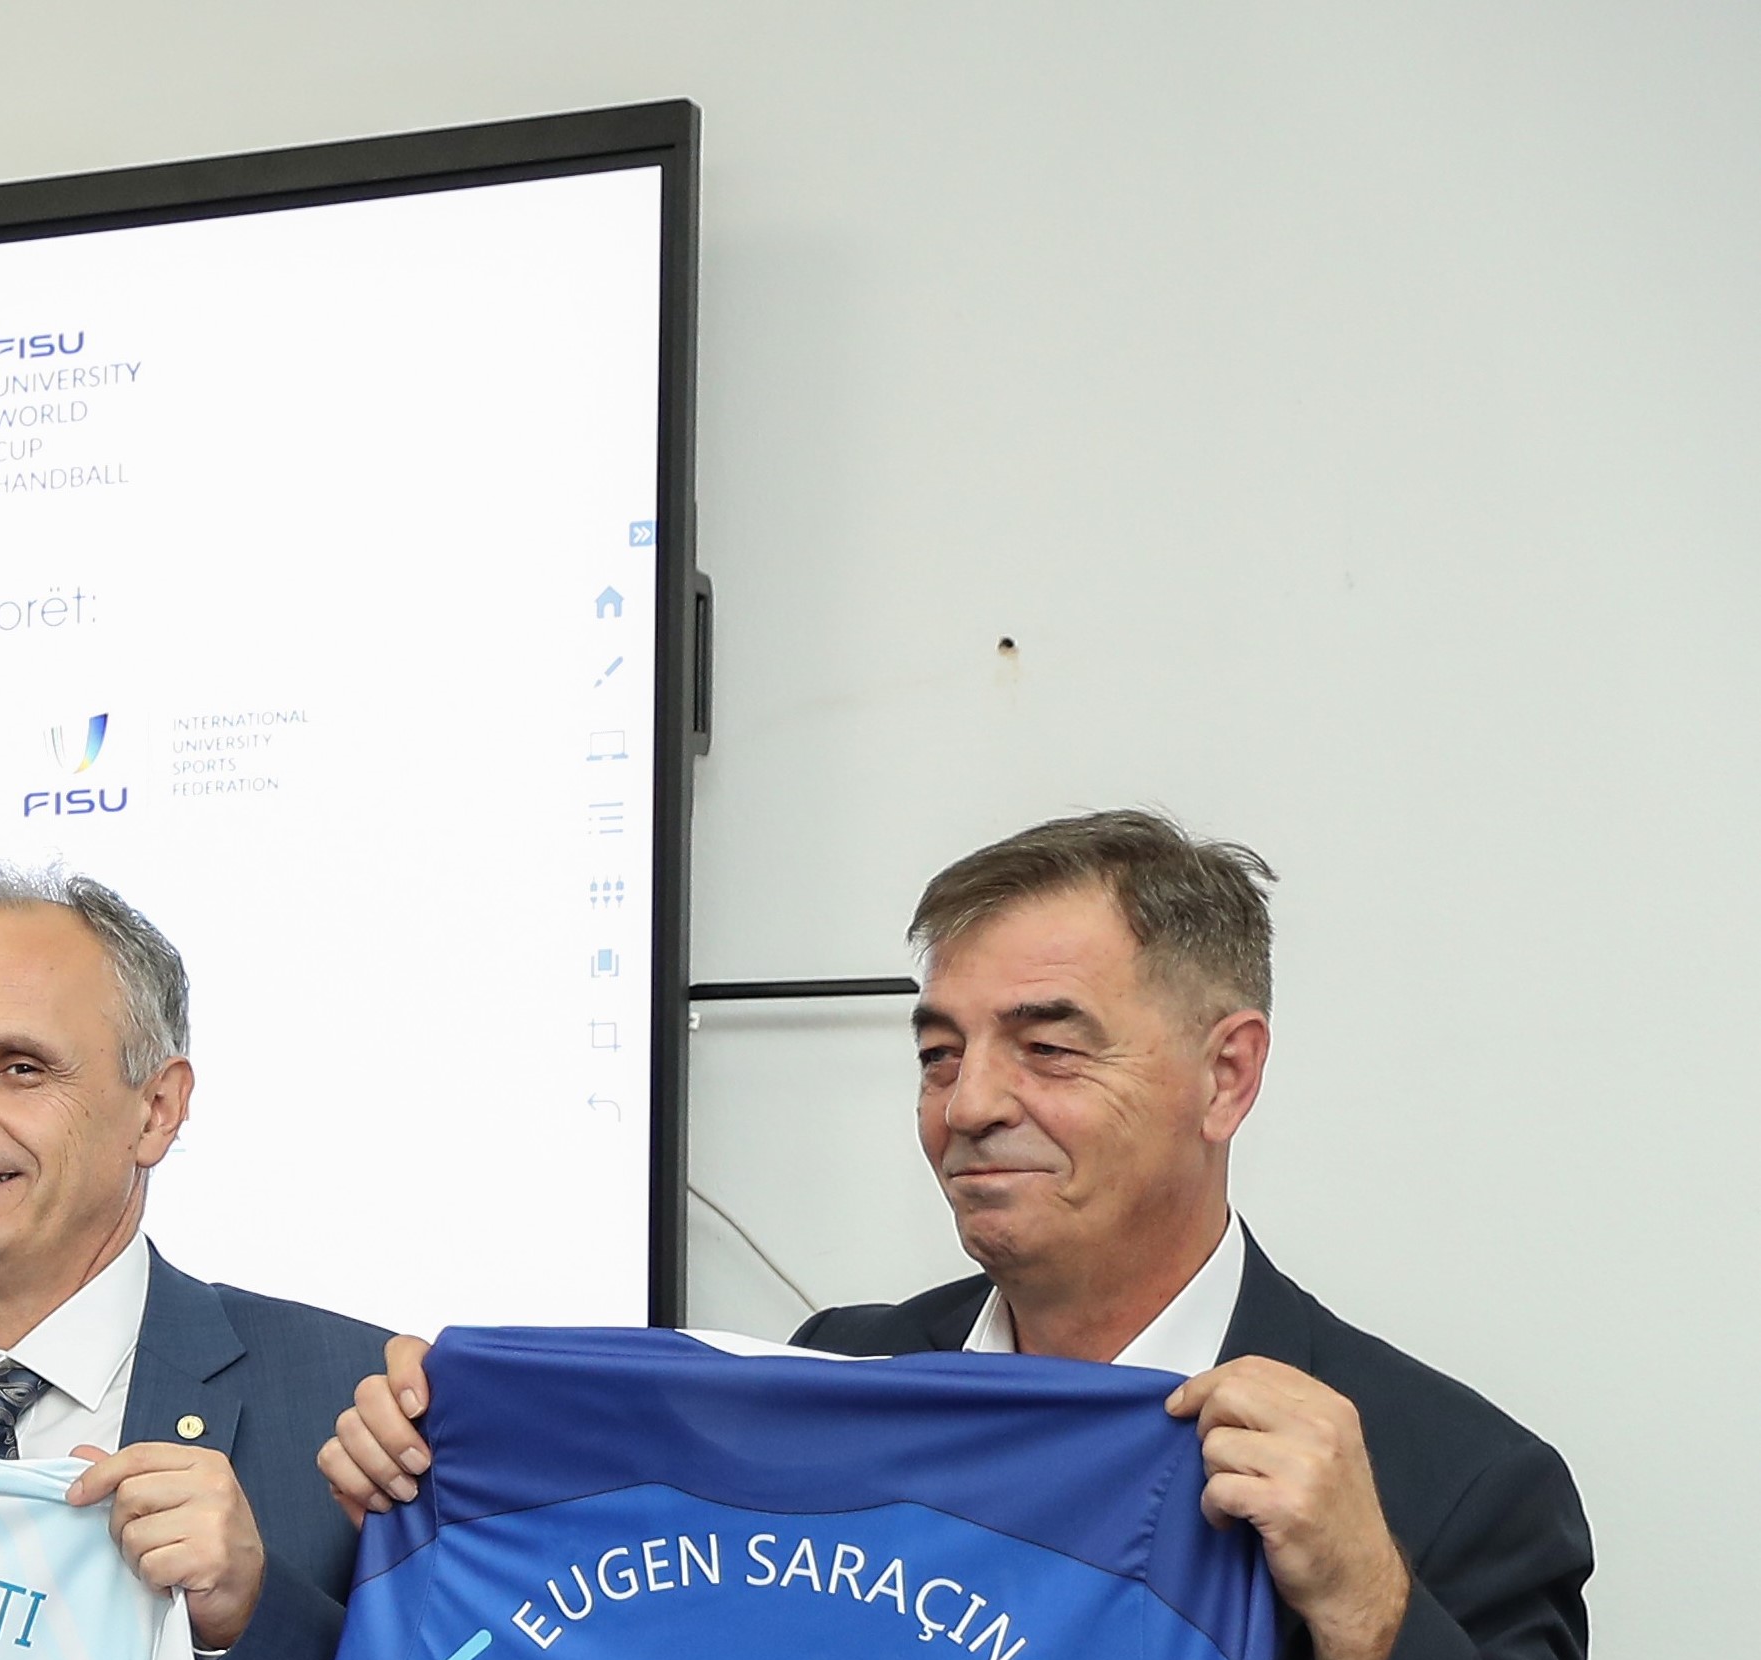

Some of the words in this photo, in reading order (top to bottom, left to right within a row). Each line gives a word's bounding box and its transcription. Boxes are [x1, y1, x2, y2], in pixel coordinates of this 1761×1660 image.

[173, 709, 309, 732] INTERNATIONAL
[173, 733, 273, 754] UNIVERSITY
[173, 757, 237, 776] SPORTS
[173, 777, 279, 798] FEDERATION
[24, 787, 128, 817] FISU
[511, 1532, 722, 1652] EUGEN
